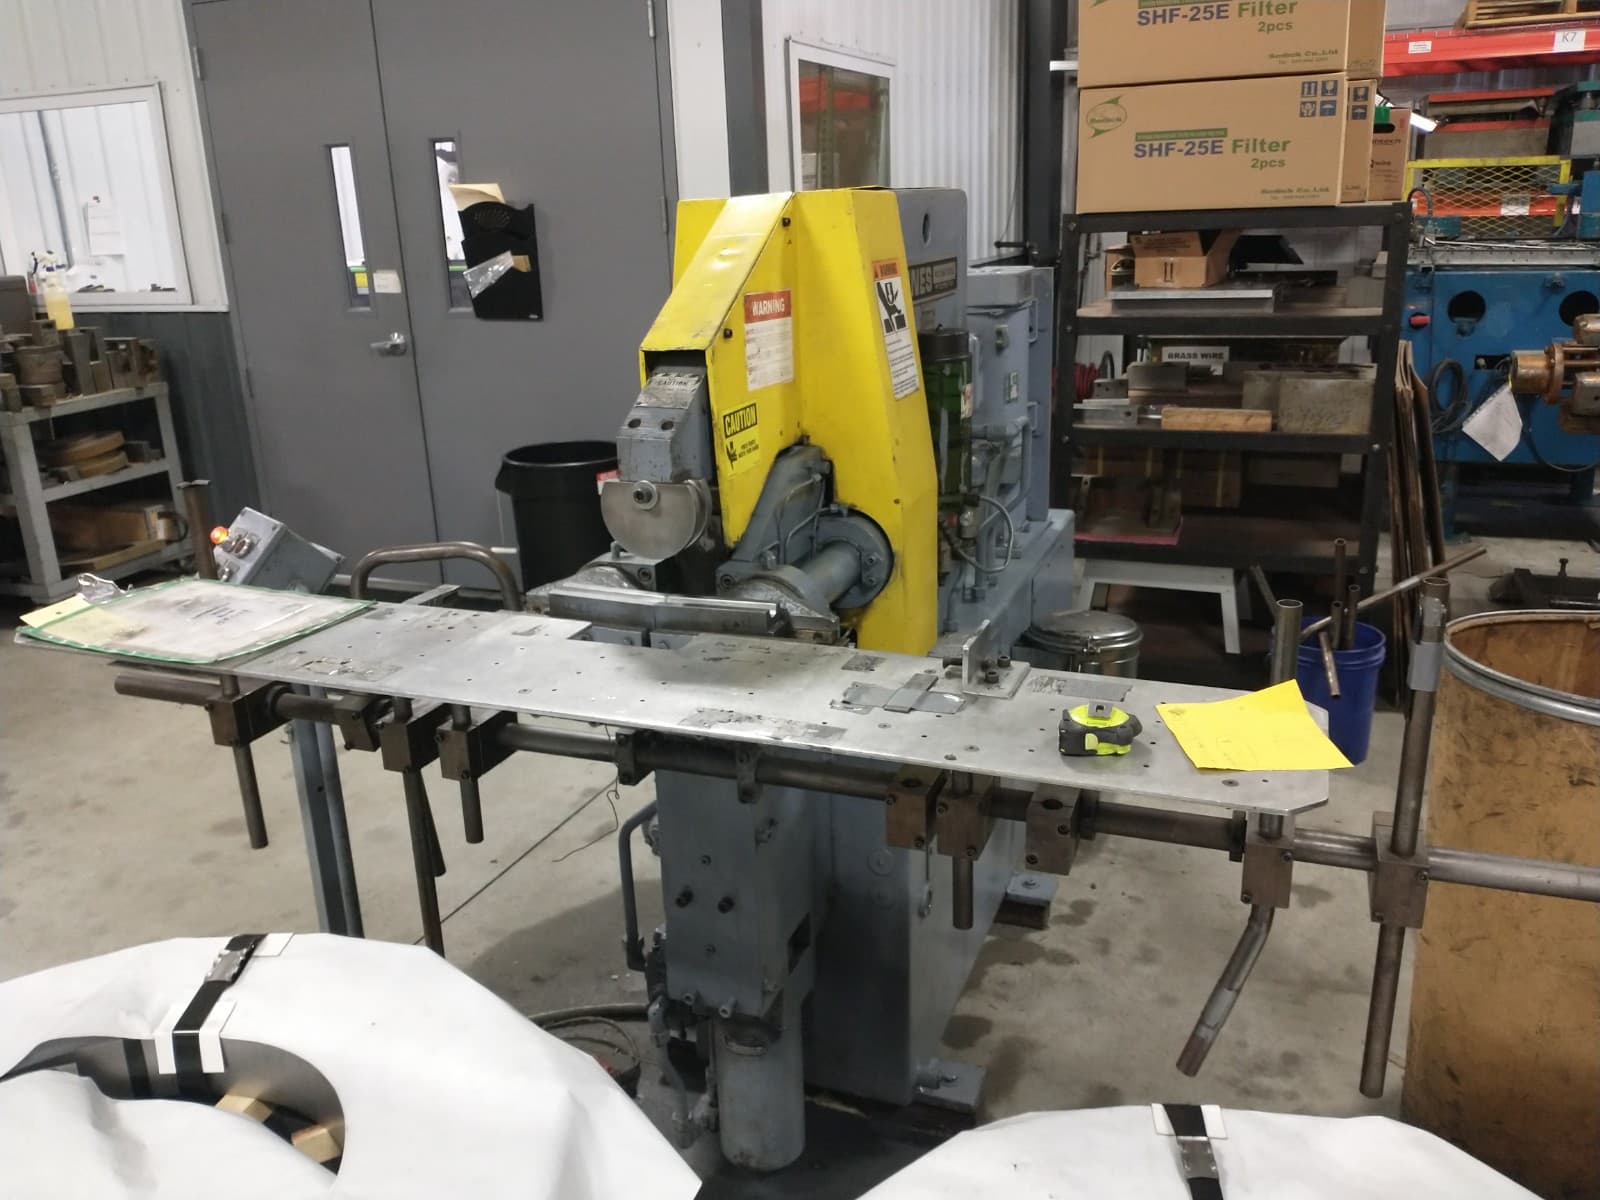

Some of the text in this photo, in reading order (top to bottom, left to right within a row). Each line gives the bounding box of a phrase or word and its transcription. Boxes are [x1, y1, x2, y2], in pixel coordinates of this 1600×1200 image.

[1137, 3, 1230, 26] SHF-25E
[1238, 0, 1298, 17] Filter
[1258, 20, 1294, 34] 2pcs
[1561, 32, 1577, 42] K7
[1134, 138, 1291, 159] SHF-25E Filter
[1250, 158, 1286, 170] 2pcs
[752, 298, 785, 317] WARNING
[1167, 352, 1224, 360] BRASS WIRE
[724, 405, 757, 436] CAUTION
